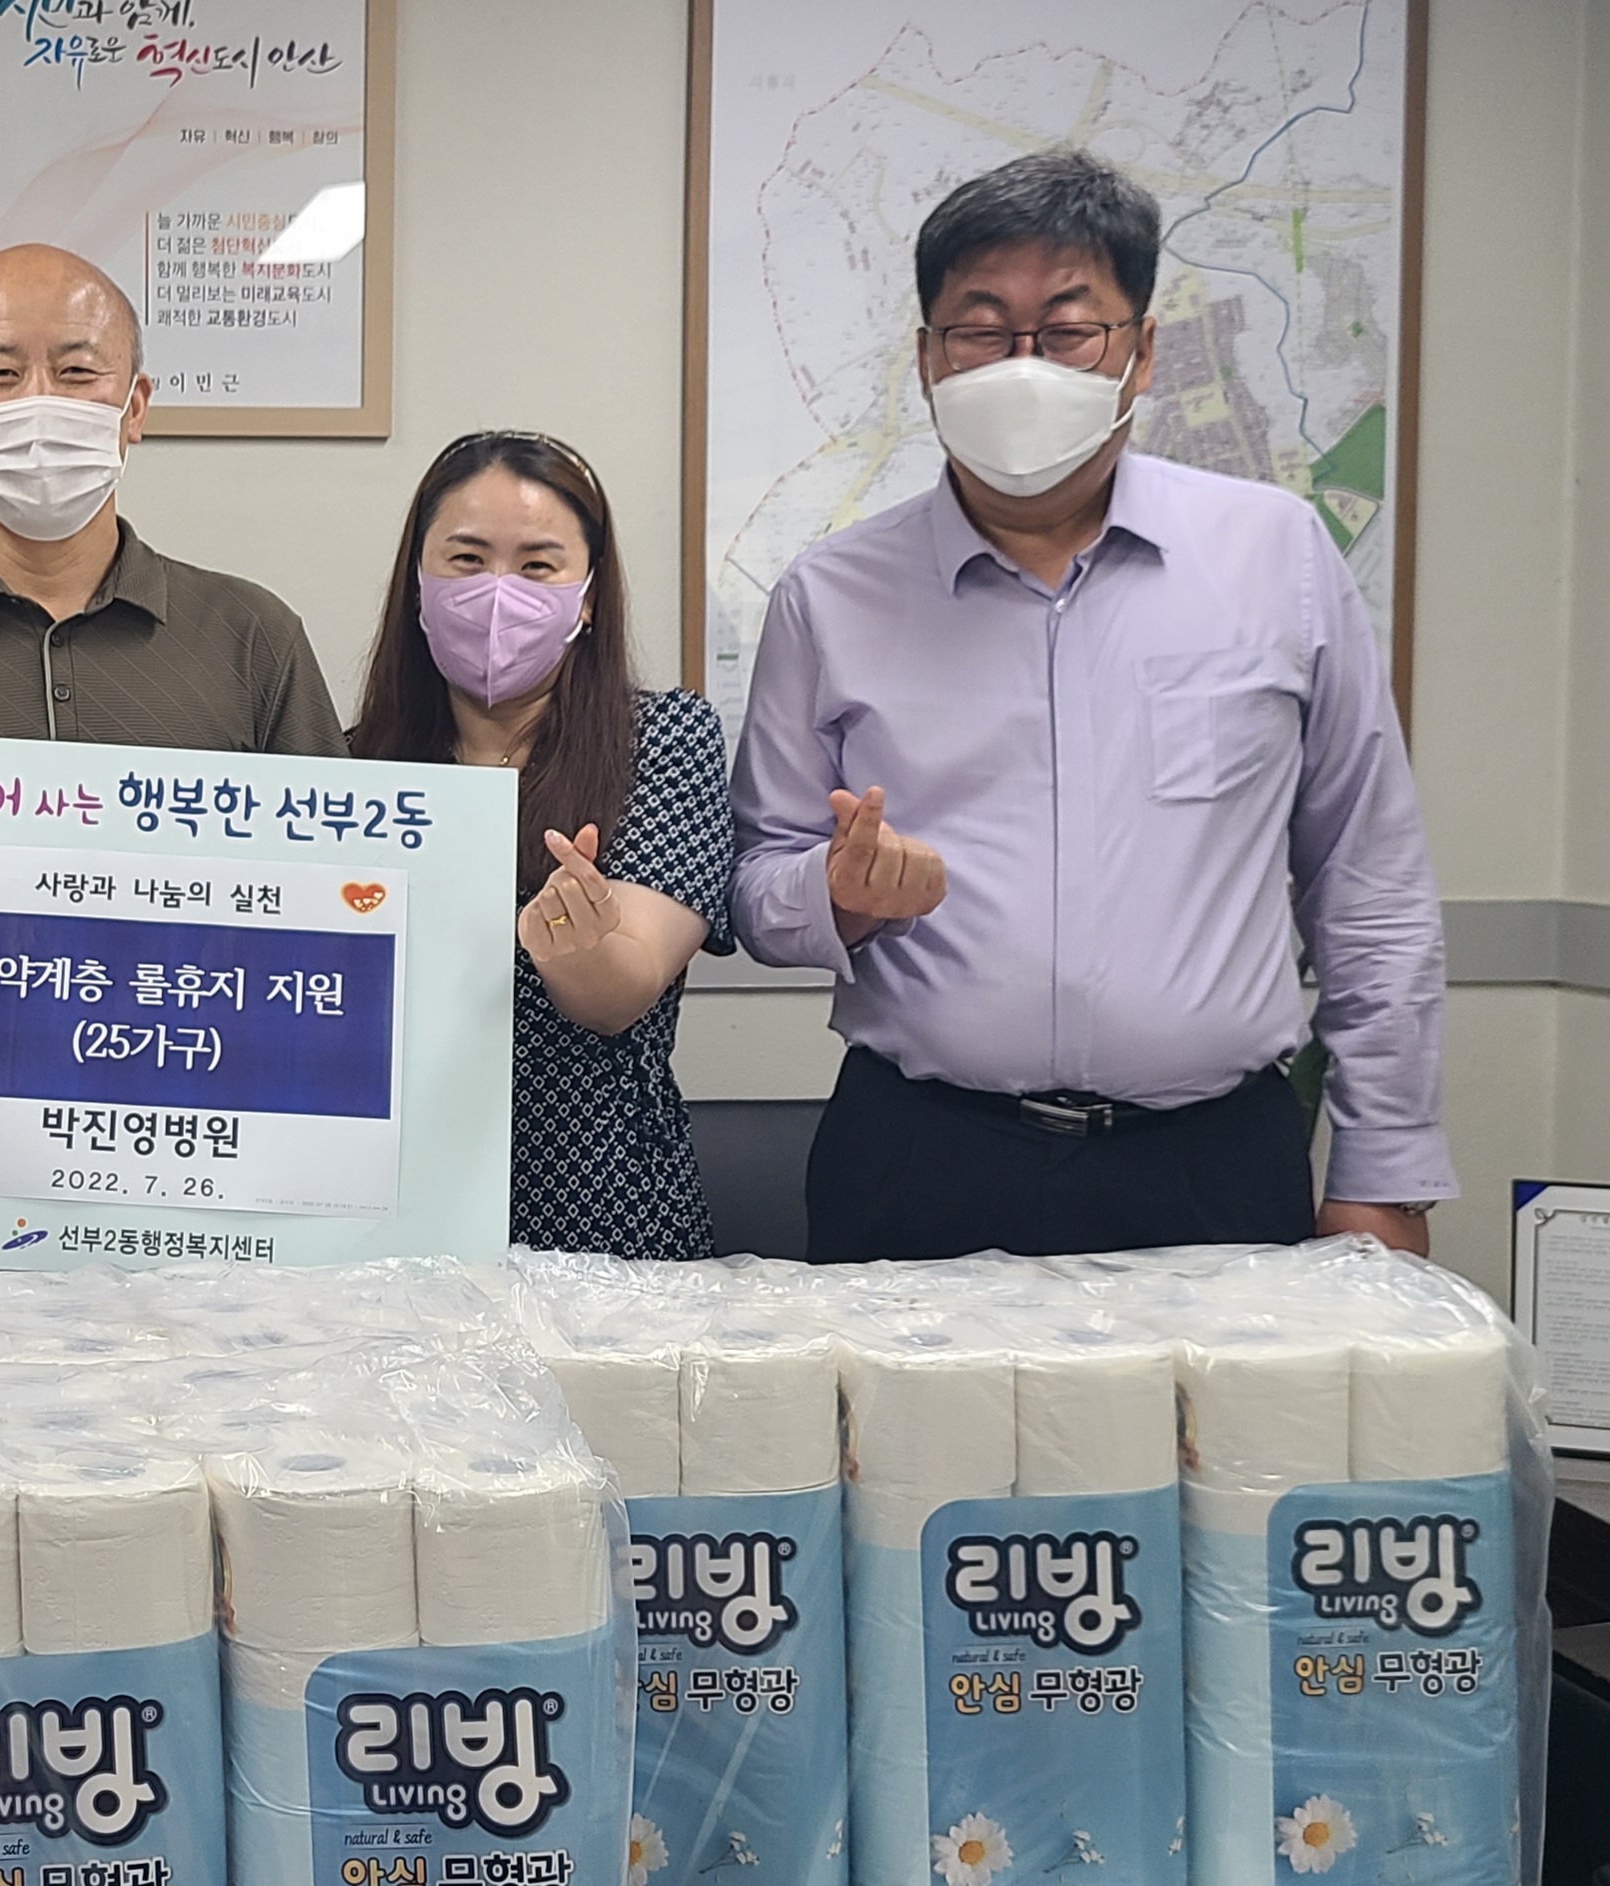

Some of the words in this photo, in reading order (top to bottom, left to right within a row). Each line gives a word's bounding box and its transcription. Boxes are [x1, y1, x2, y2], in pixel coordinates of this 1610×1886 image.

[24, 35, 127, 91] 자유로운
[136, 34, 261, 89] 혁신도시
[267, 41, 344, 75] 안산
[179, 129, 206, 144] 자유
[224, 129, 251, 144] 혁신
[268, 129, 295, 145] 행복
[157, 212, 172, 231] 늘
[176, 212, 223, 231] 가까운
[157, 236, 172, 254] 더
[176, 236, 207, 255] 젊은
[157, 260, 188, 279] 함께
[191, 260, 237, 279] 행복한
[240, 261, 332, 280] 복지문화도시
[157, 285, 172, 303] 더
[176, 285, 237, 304] 멀리보는
[240, 285, 332, 304] 미래교육도시
[157, 309, 202, 327] 쾌적한
[206, 309, 298, 328] 교통환경도시
[34, 783, 104, 825] 사는
[118, 769, 260, 838] 행복한
[274, 790, 433, 850] 선부2동
[35, 872, 117, 904] 사랑과
[133, 878, 212, 909] 나눔의
[230, 884, 282, 915] 실천
[128, 959, 247, 1013] 롤휴지
[267, 966, 345, 1017] 지원
[71, 1020, 223, 1073] (25가구)
[41, 1104, 241, 1161] 박진영병원
[51, 1168, 129, 1196] 2022.
[144, 1175, 168, 1198] 7.
[182, 1176, 226, 1201] 26.
[57, 1225, 276, 1266] 선부2동행정복지센터
[955, 1540, 1132, 1646] 리빙
[1301, 1522, 1473, 1628] 리빙
[660, 1647, 683, 1661] safe
[1002, 1647, 1027, 1662] safe
[1294, 1653, 1366, 1697] 안심
[1371, 1648, 1482, 1697] 무형광
[686, 1666, 800, 1716] 무형광
[950, 1671, 1021, 1715] 안심
[1028, 1666, 1144, 1715] 무형광
[347, 1698, 558, 1826] 리빙
[2, 1838, 31, 1856] safe
[344, 1830, 388, 1847] natural
[393, 1830, 401, 1844] &
[404, 1828, 433, 1845] safe
